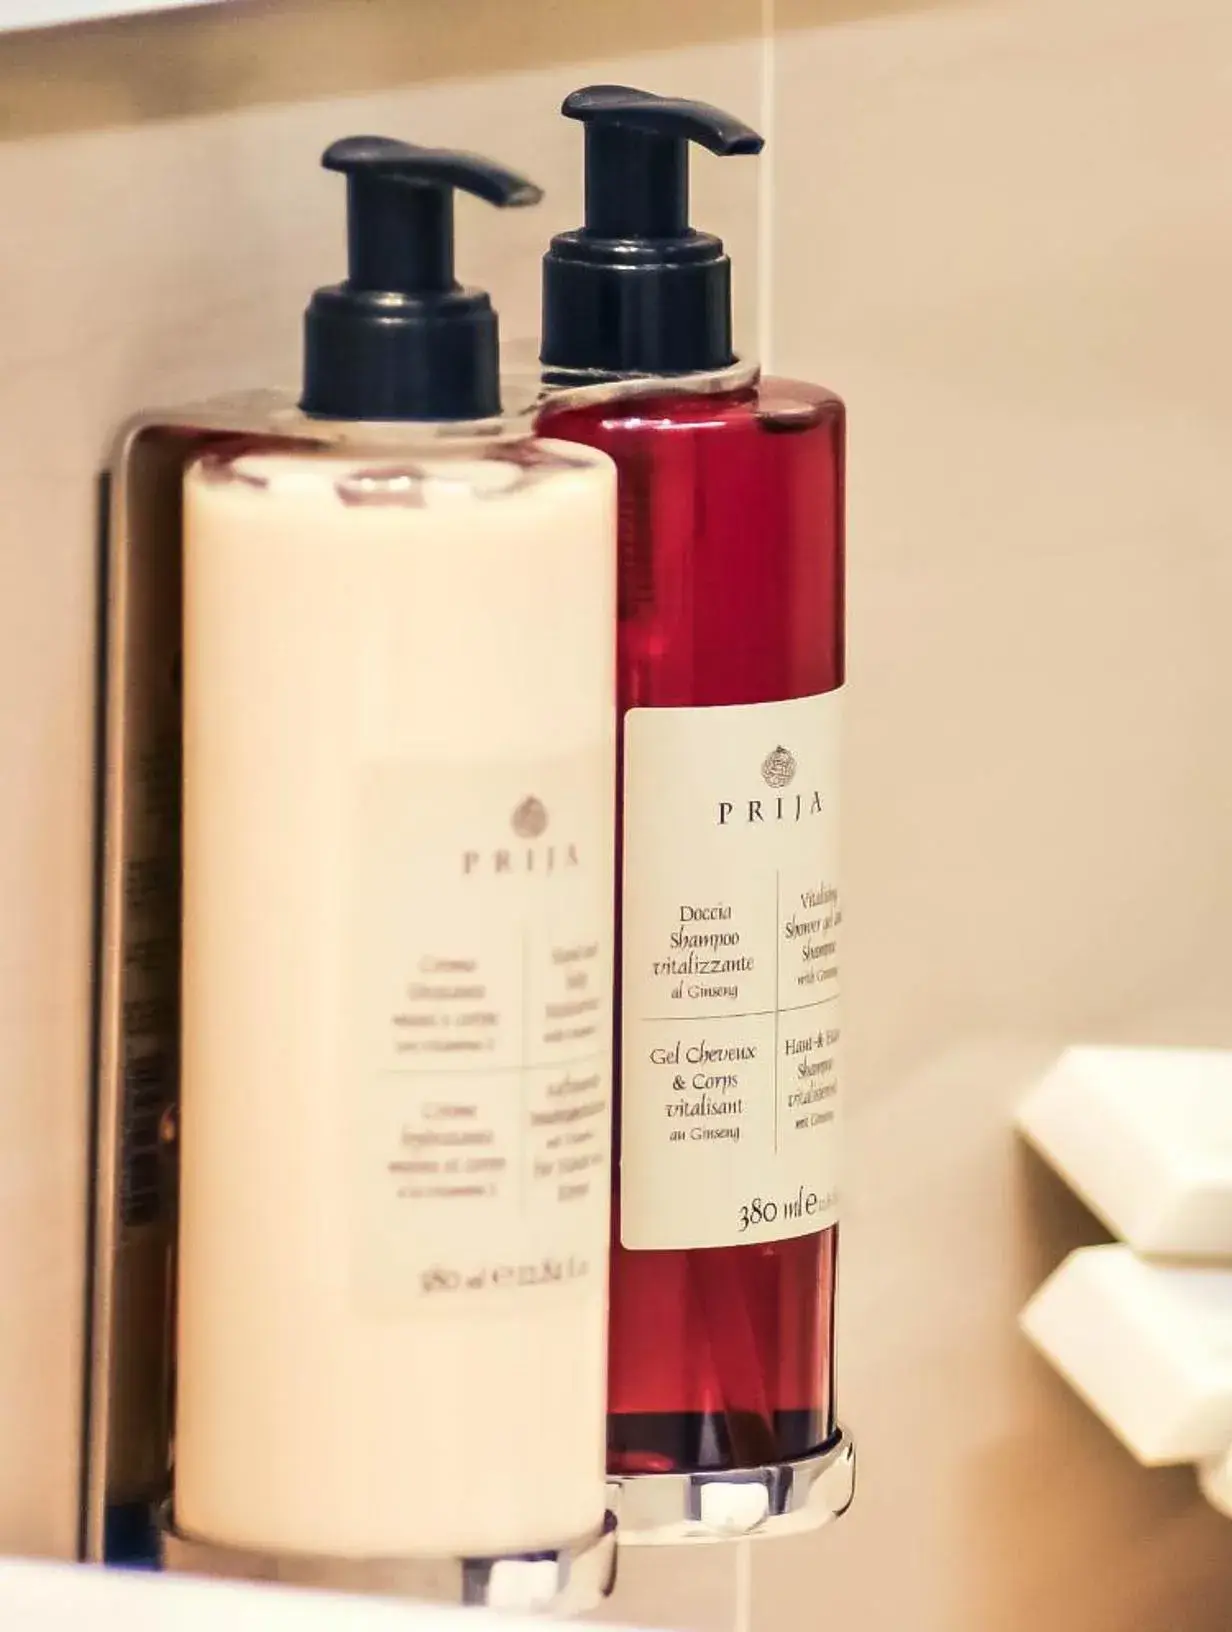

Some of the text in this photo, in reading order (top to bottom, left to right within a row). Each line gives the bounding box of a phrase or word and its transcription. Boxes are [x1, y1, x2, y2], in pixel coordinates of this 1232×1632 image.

[717, 791, 823, 825] PRIJA
[462, 843, 579, 877] PRIJA
[679, 903, 732, 922] Doccia
[670, 926, 740, 950] Shampoo
[653, 951, 754, 976] vitalizzante
[671, 980, 739, 1001] al Ginseng
[649, 1040, 757, 1067] Gel Cheveux
[672, 1073, 739, 1094] & Corps
[665, 1094, 743, 1118] vitalisant
[669, 1129, 686, 1142] au
[737, 1198, 778, 1233] 380
[784, 1185, 804, 1219] ml
